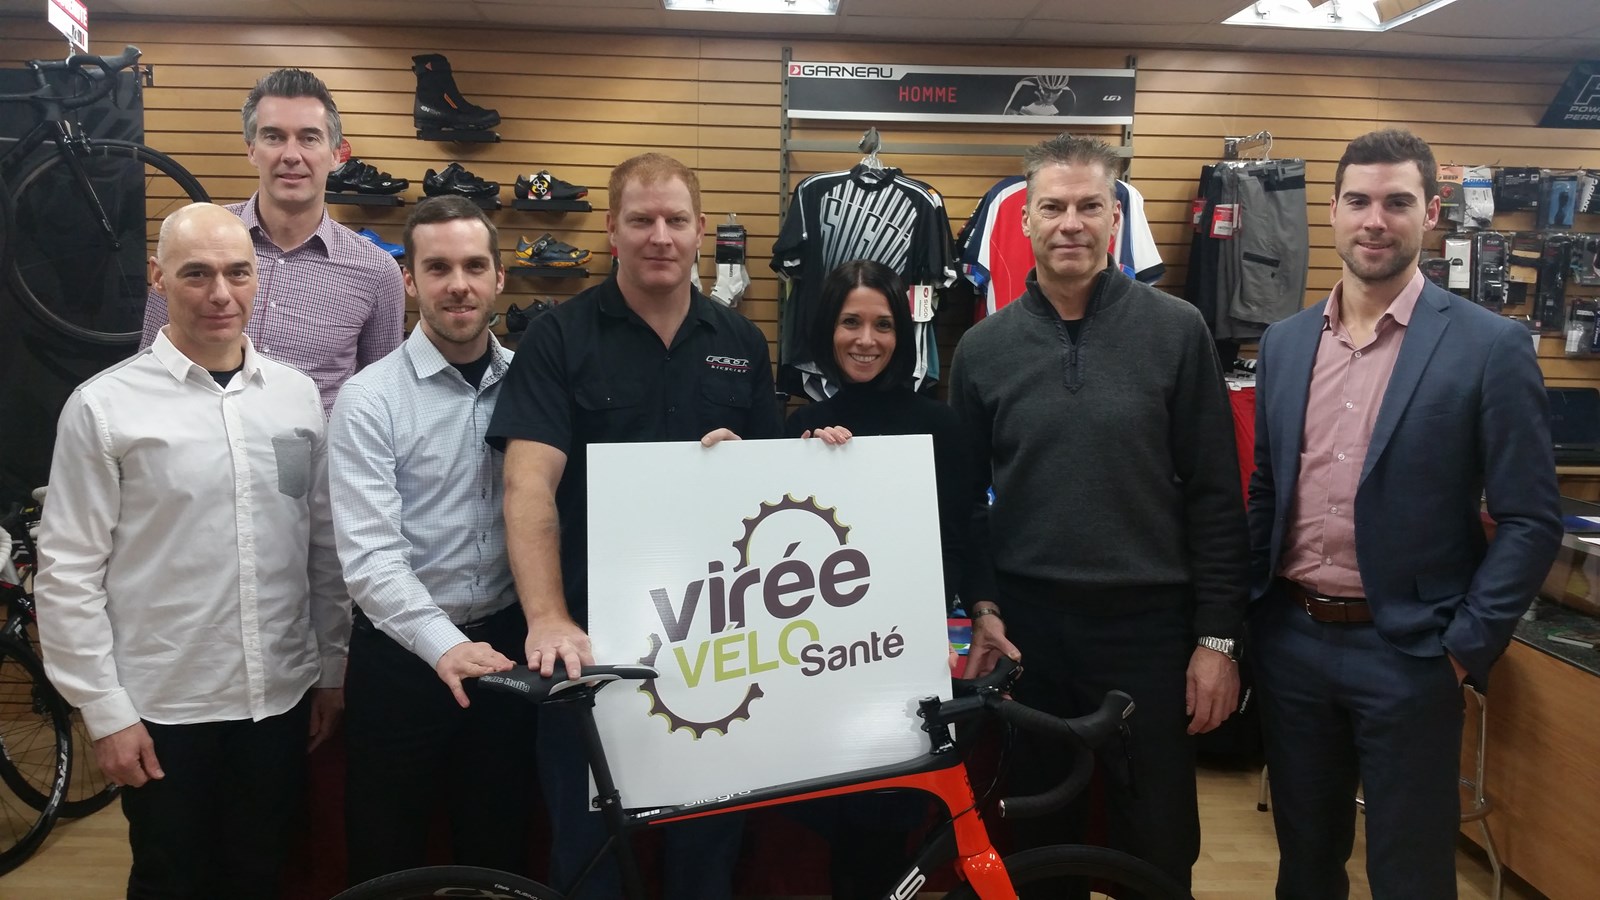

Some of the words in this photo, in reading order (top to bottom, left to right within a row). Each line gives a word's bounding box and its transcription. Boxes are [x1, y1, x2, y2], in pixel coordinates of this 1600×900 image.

[802, 64, 893, 79] GARNEAU
[899, 86, 958, 103] HOMME
[1568, 105, 1600, 113] POW
[649, 541, 871, 644] virée
[672, 619, 820, 689] VÉLO
[800, 625, 905, 677] Santé
